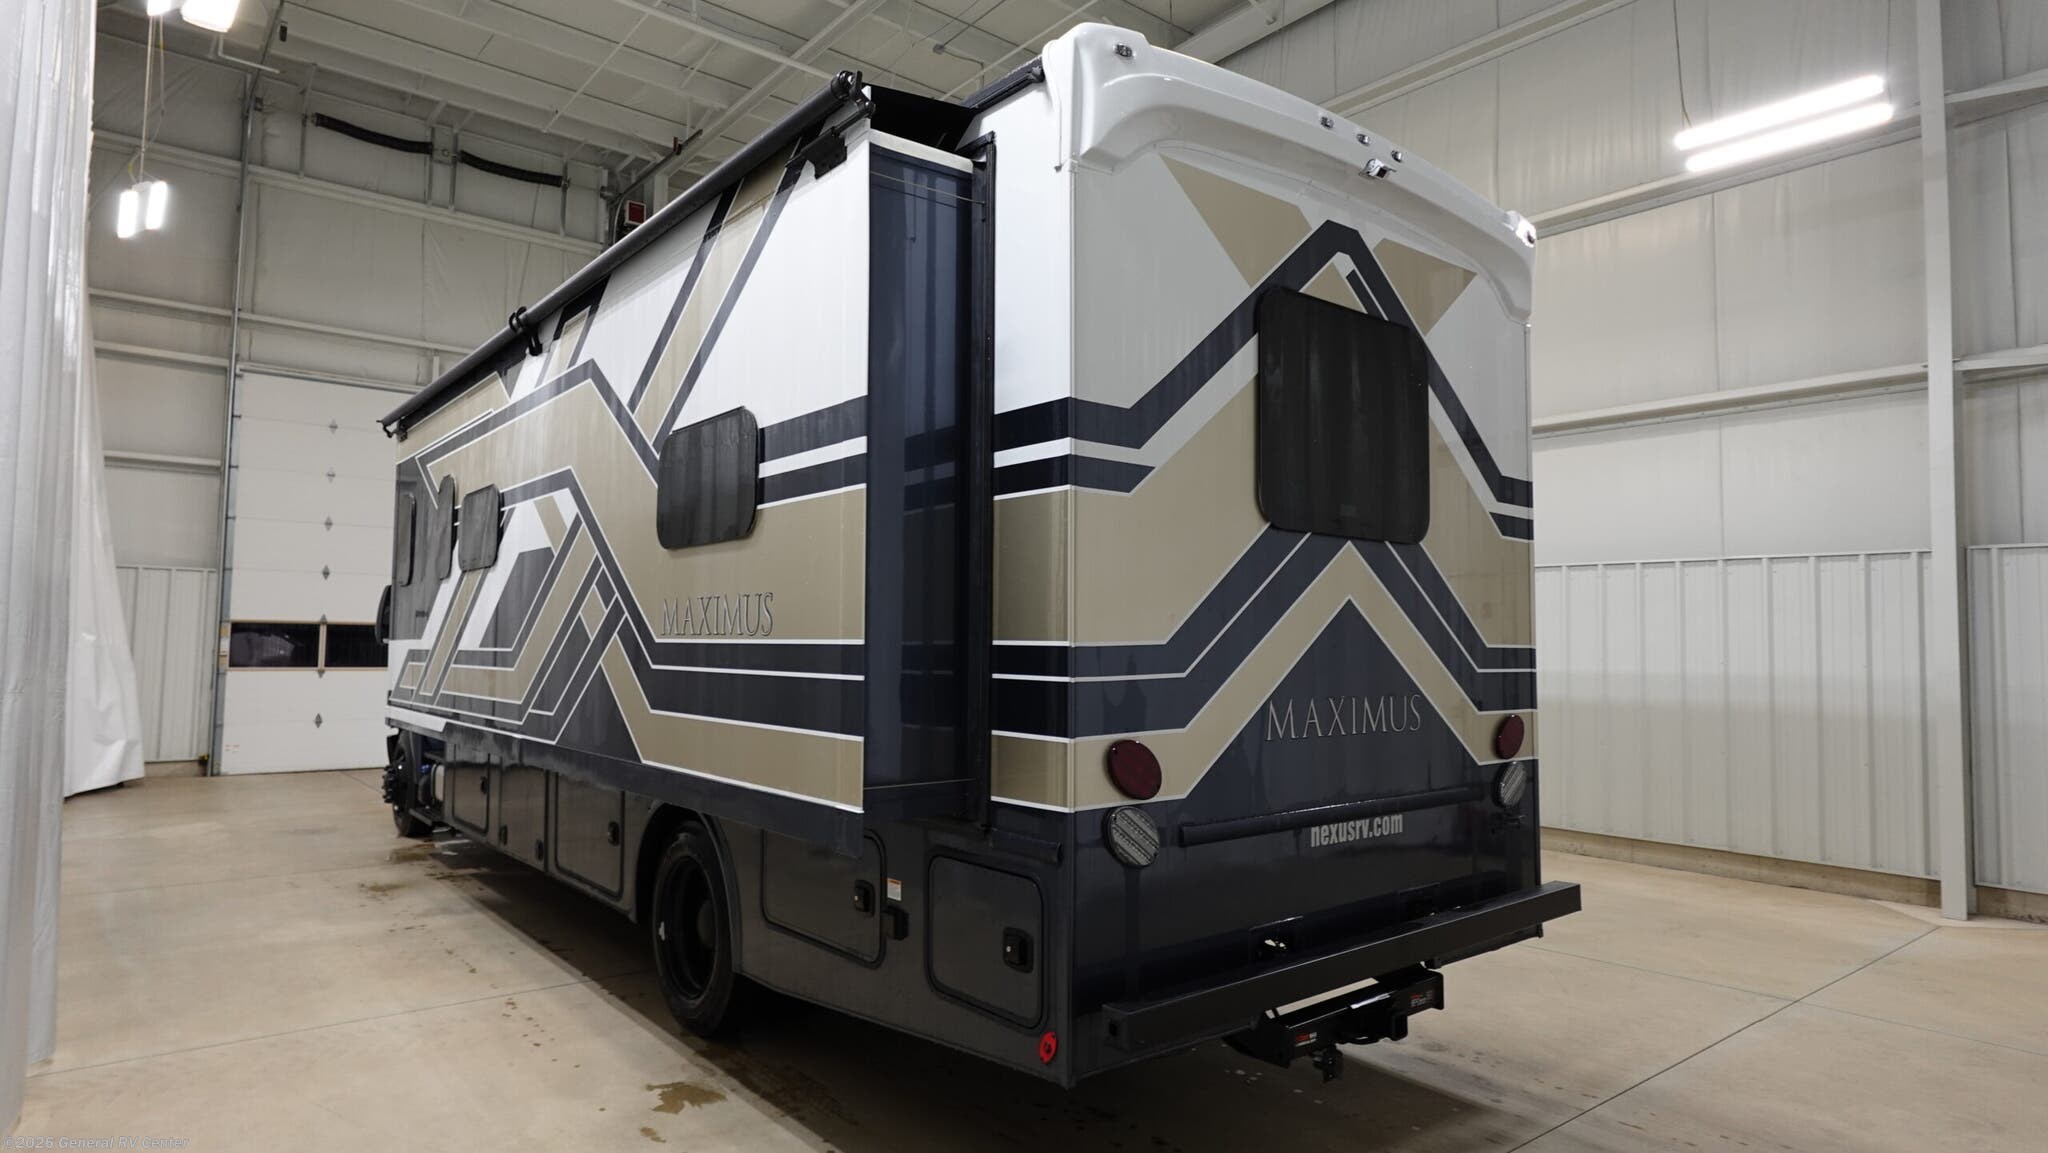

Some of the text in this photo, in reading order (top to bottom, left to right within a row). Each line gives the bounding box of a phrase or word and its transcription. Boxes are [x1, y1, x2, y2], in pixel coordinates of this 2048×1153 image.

[661, 592, 773, 636] MAXIMUS
[1266, 694, 1421, 741] MAXIMUS
[1310, 814, 1403, 848] nexusrv.com
